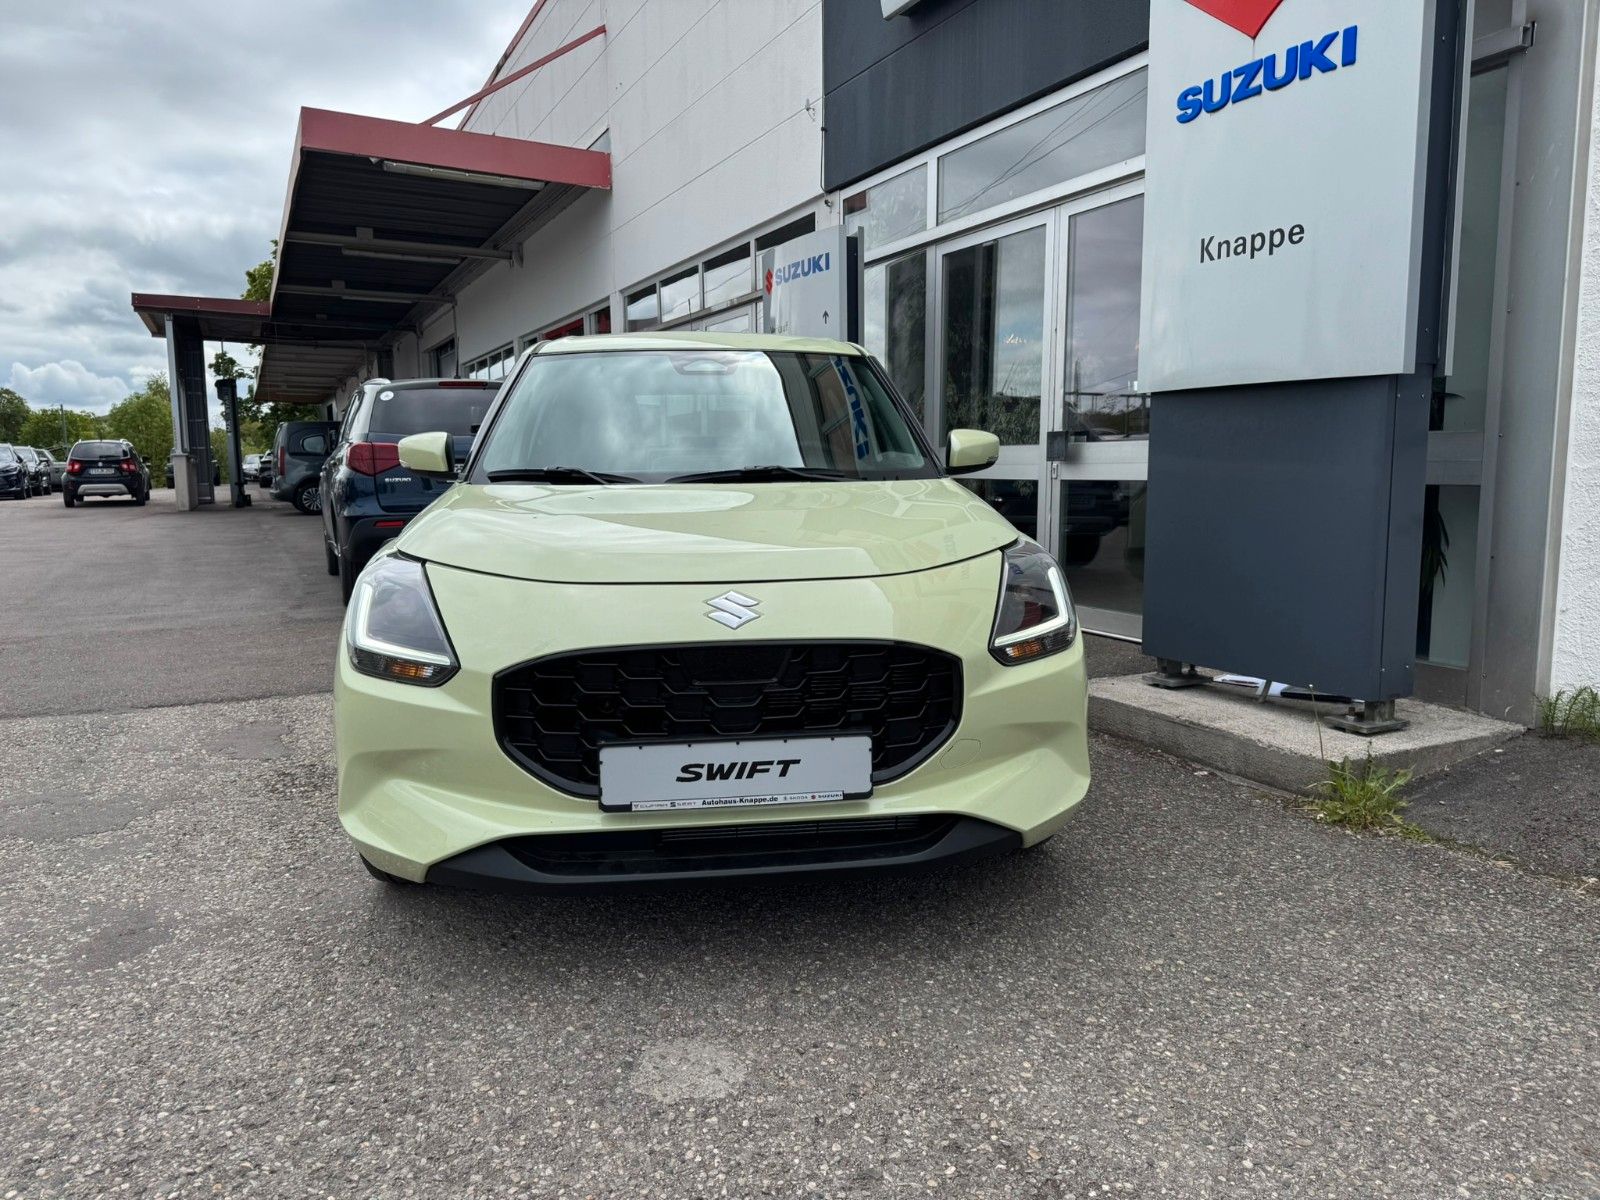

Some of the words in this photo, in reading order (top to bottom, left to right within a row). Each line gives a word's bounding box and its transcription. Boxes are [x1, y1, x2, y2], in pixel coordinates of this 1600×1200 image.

[1176, 25, 1358, 124] SUZUKI
[1200, 223, 1305, 263] Knappe
[775, 252, 830, 286] SUZUKI
[676, 759, 801, 782] SWIFT
[702, 796, 779, 806] Autohaus-Knappe.de
